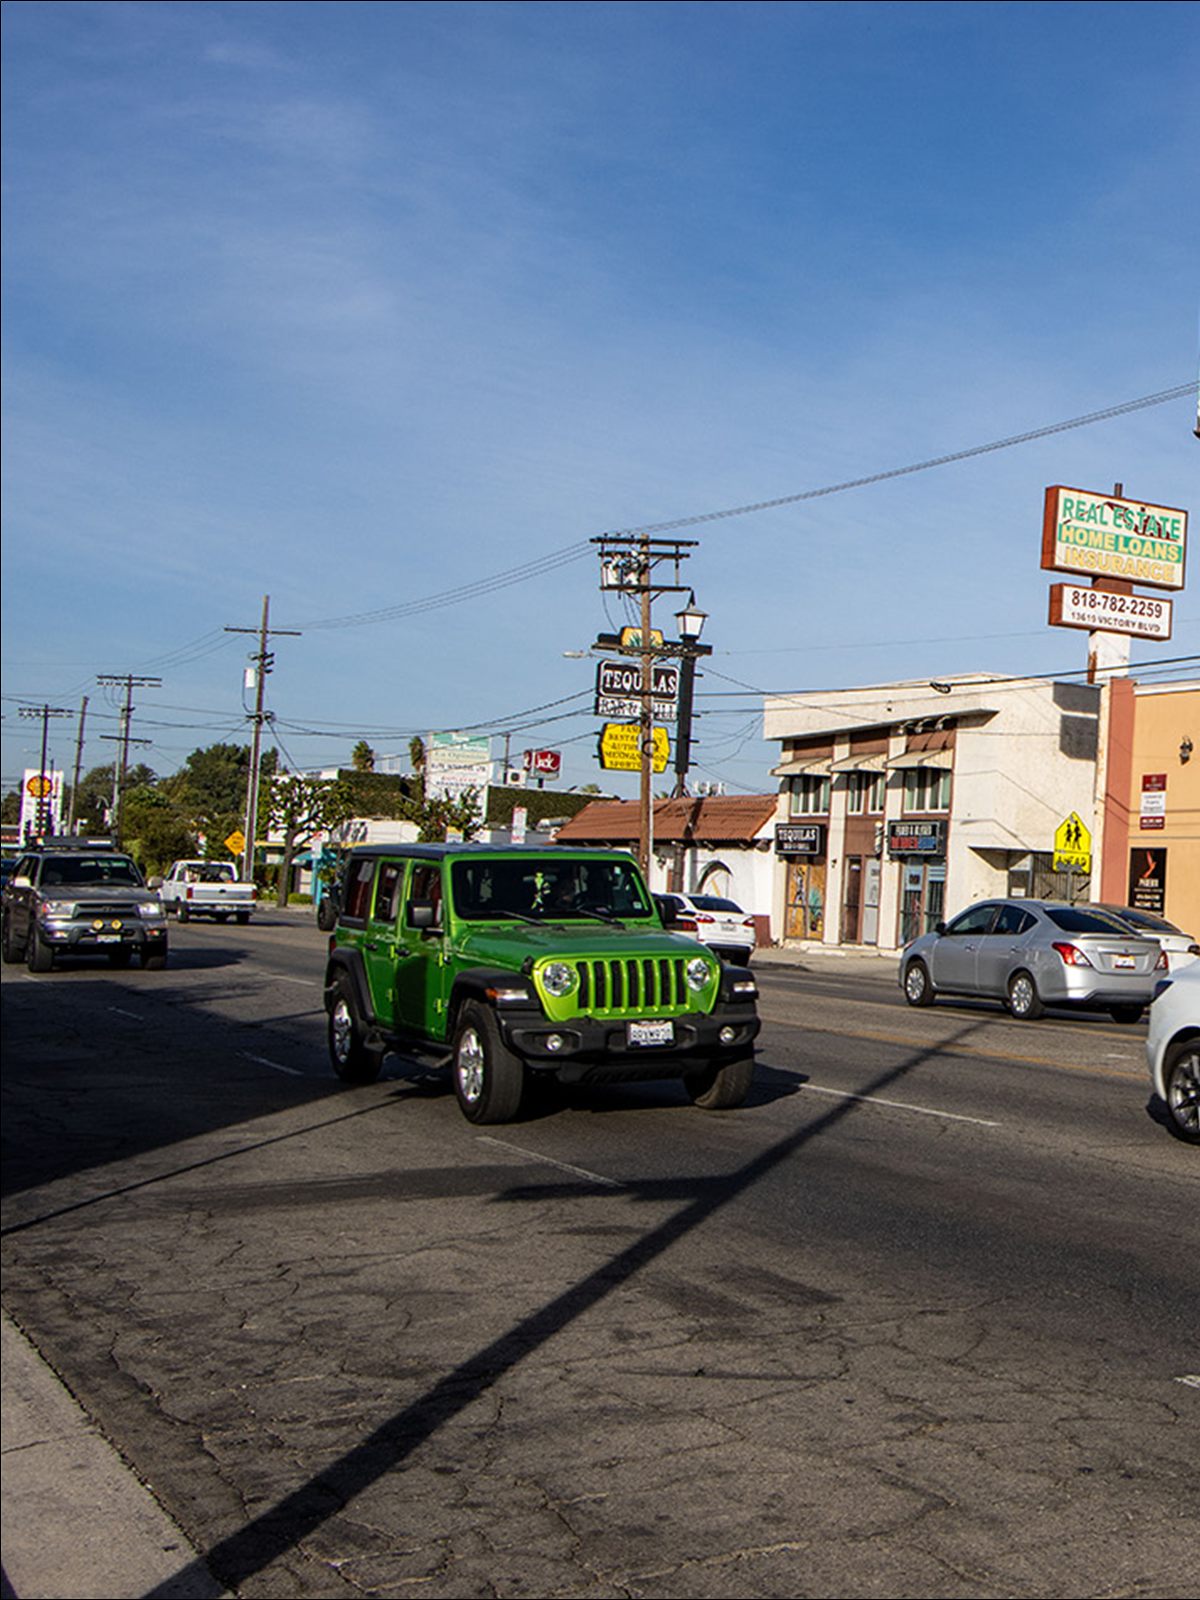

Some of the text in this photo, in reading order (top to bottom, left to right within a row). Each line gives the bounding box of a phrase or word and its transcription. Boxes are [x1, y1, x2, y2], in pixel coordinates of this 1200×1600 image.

[1062, 498, 1181, 539] REAL ESTATE
[1062, 525, 1179, 561] HOME LOANS
[1064, 546, 1175, 582] INSURANCE
[1071, 590, 1162, 618] 818-782-2259
[1098, 616, 1136, 628] VICTORY
[1138, 621, 1161, 632] BLVD
[603, 669, 677, 694] TEQULAS
[778, 829, 816, 842] TEQUILAS
